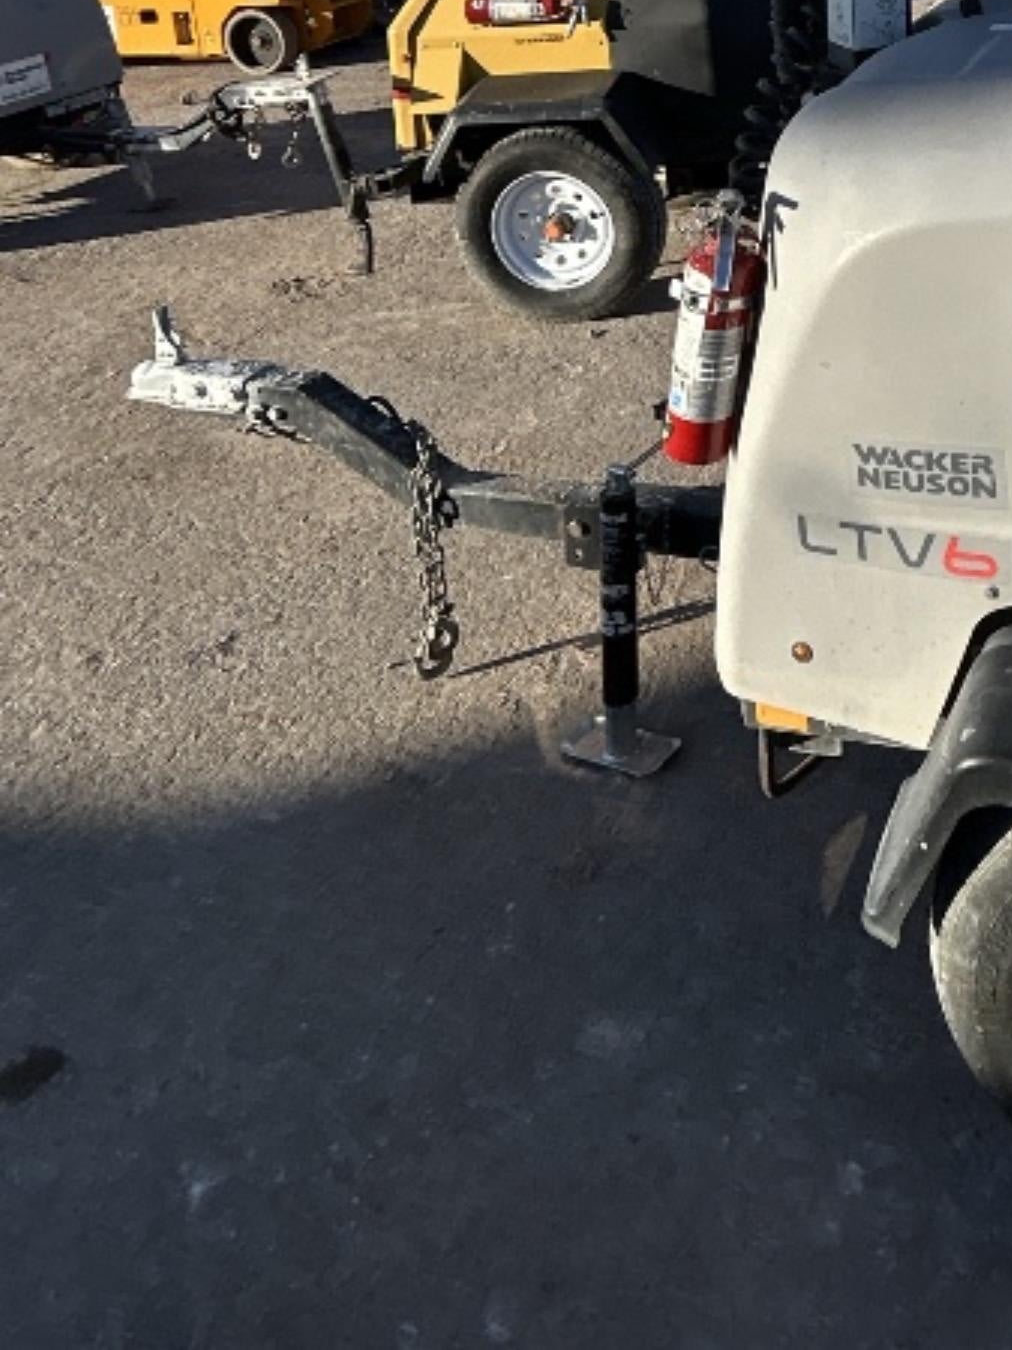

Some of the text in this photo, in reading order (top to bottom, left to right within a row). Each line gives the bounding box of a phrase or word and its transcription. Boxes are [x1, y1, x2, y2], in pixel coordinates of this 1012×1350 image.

[851, 443, 995, 476] WACKER
[857, 466, 997, 499] NEUSON
[797, 513, 998, 580] LTV6
